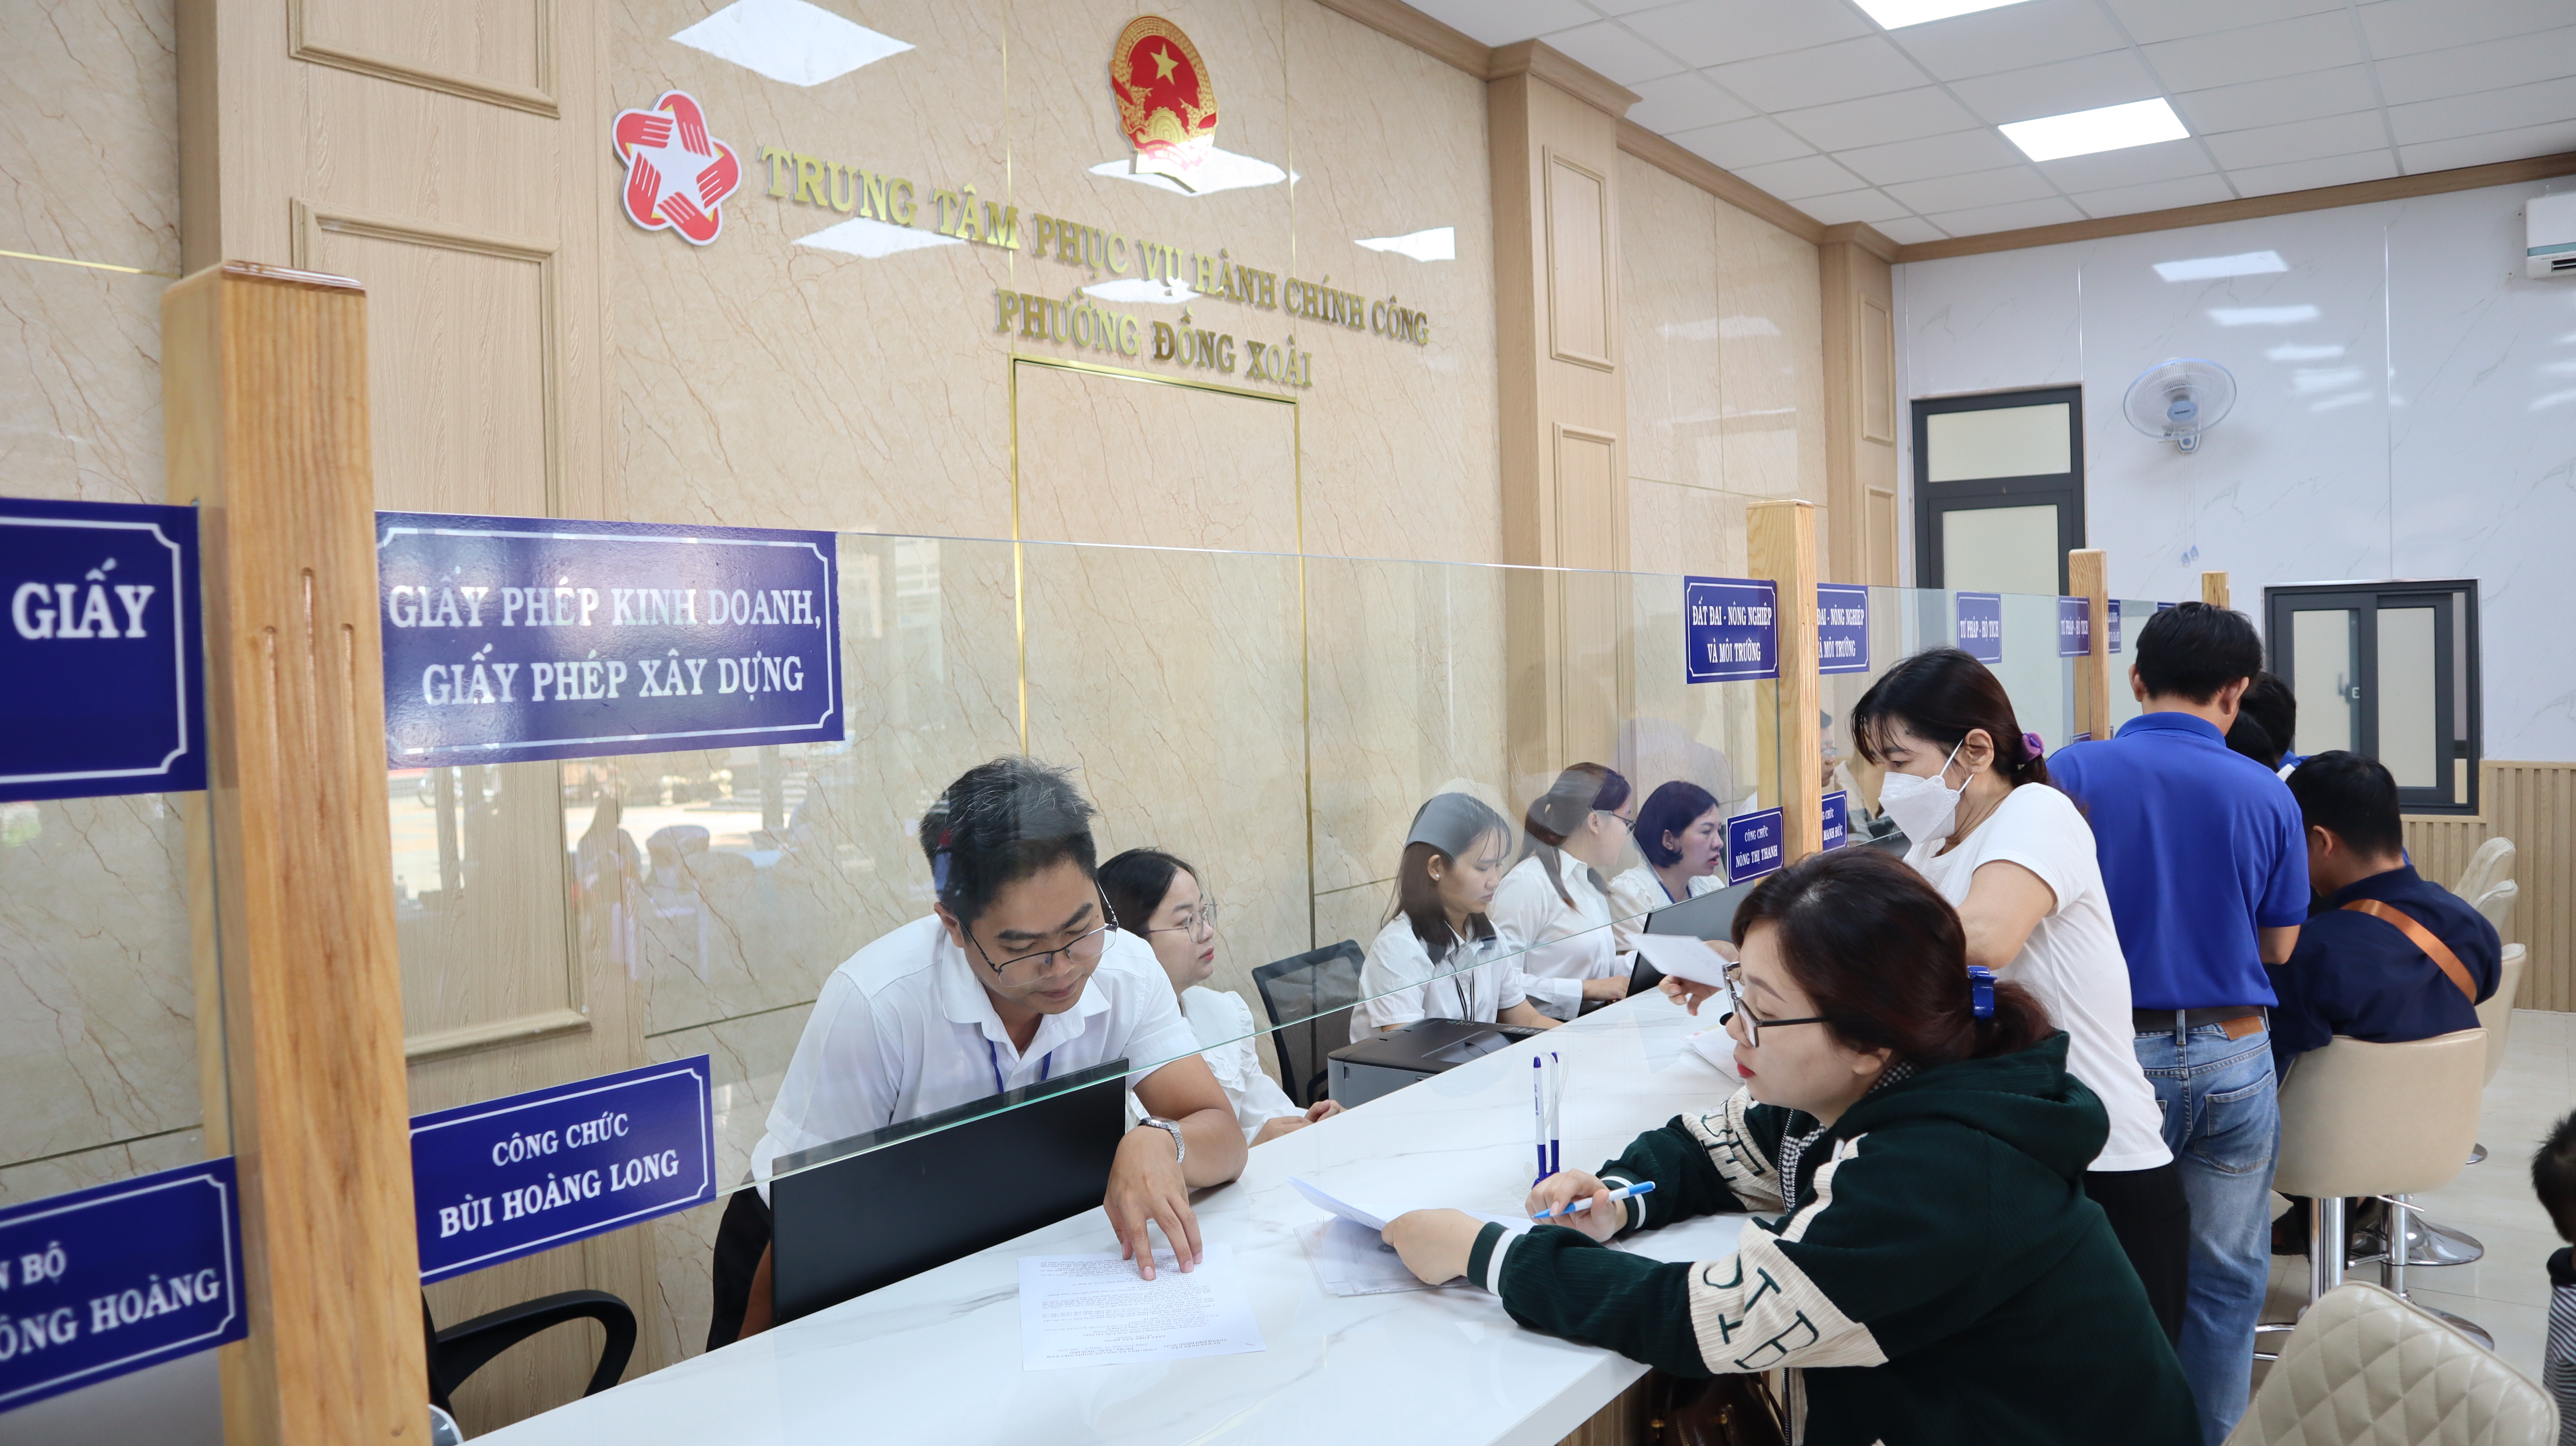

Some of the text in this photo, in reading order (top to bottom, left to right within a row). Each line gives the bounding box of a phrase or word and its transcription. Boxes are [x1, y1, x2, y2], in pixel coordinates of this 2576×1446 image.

[758, 145, 1429, 345] TRUNG TÂM PHỤC VỤ HÀNH CHÍNH CÔNG
[994, 286, 1312, 386] PHƯỜNG ĐỒNG XOÀI
[12, 557, 155, 640] GIẤY
[389, 565, 821, 629] GIẤY PHÉP KINH DOANH,
[1692, 596, 1708, 626] ĐẤT
[1709, 606, 1722, 626] ĐAI
[1728, 601, 1746, 626] NÔNG
[1747, 602, 1772, 630] NGHIỆP
[1830, 604, 1845, 626] NÔNG
[1846, 605, 1864, 629] NGHIỆP
[1707, 637, 1761, 663] VÀ MÔI TRƯỜNG
[1818, 635, 1856, 658] À MÔI TRƯỜNG
[1967, 615, 1979, 638] PHÁP
[1989, 620, 1999, 642] TỊCH
[422, 643, 804, 705] GIẤY PHÉP XÂY DỰNG
[1736, 845, 1777, 868] NÔNG THỊ THANH
[1745, 825, 1768, 842] CÔNG CHỨC
[492, 1111, 629, 1166] CÔNG CHỨC
[439, 1149, 679, 1238] BÙI HOÀNG LONG
[21, 1240, 67, 1284] BỘ
[88, 1268, 221, 1334] HOÀNG
